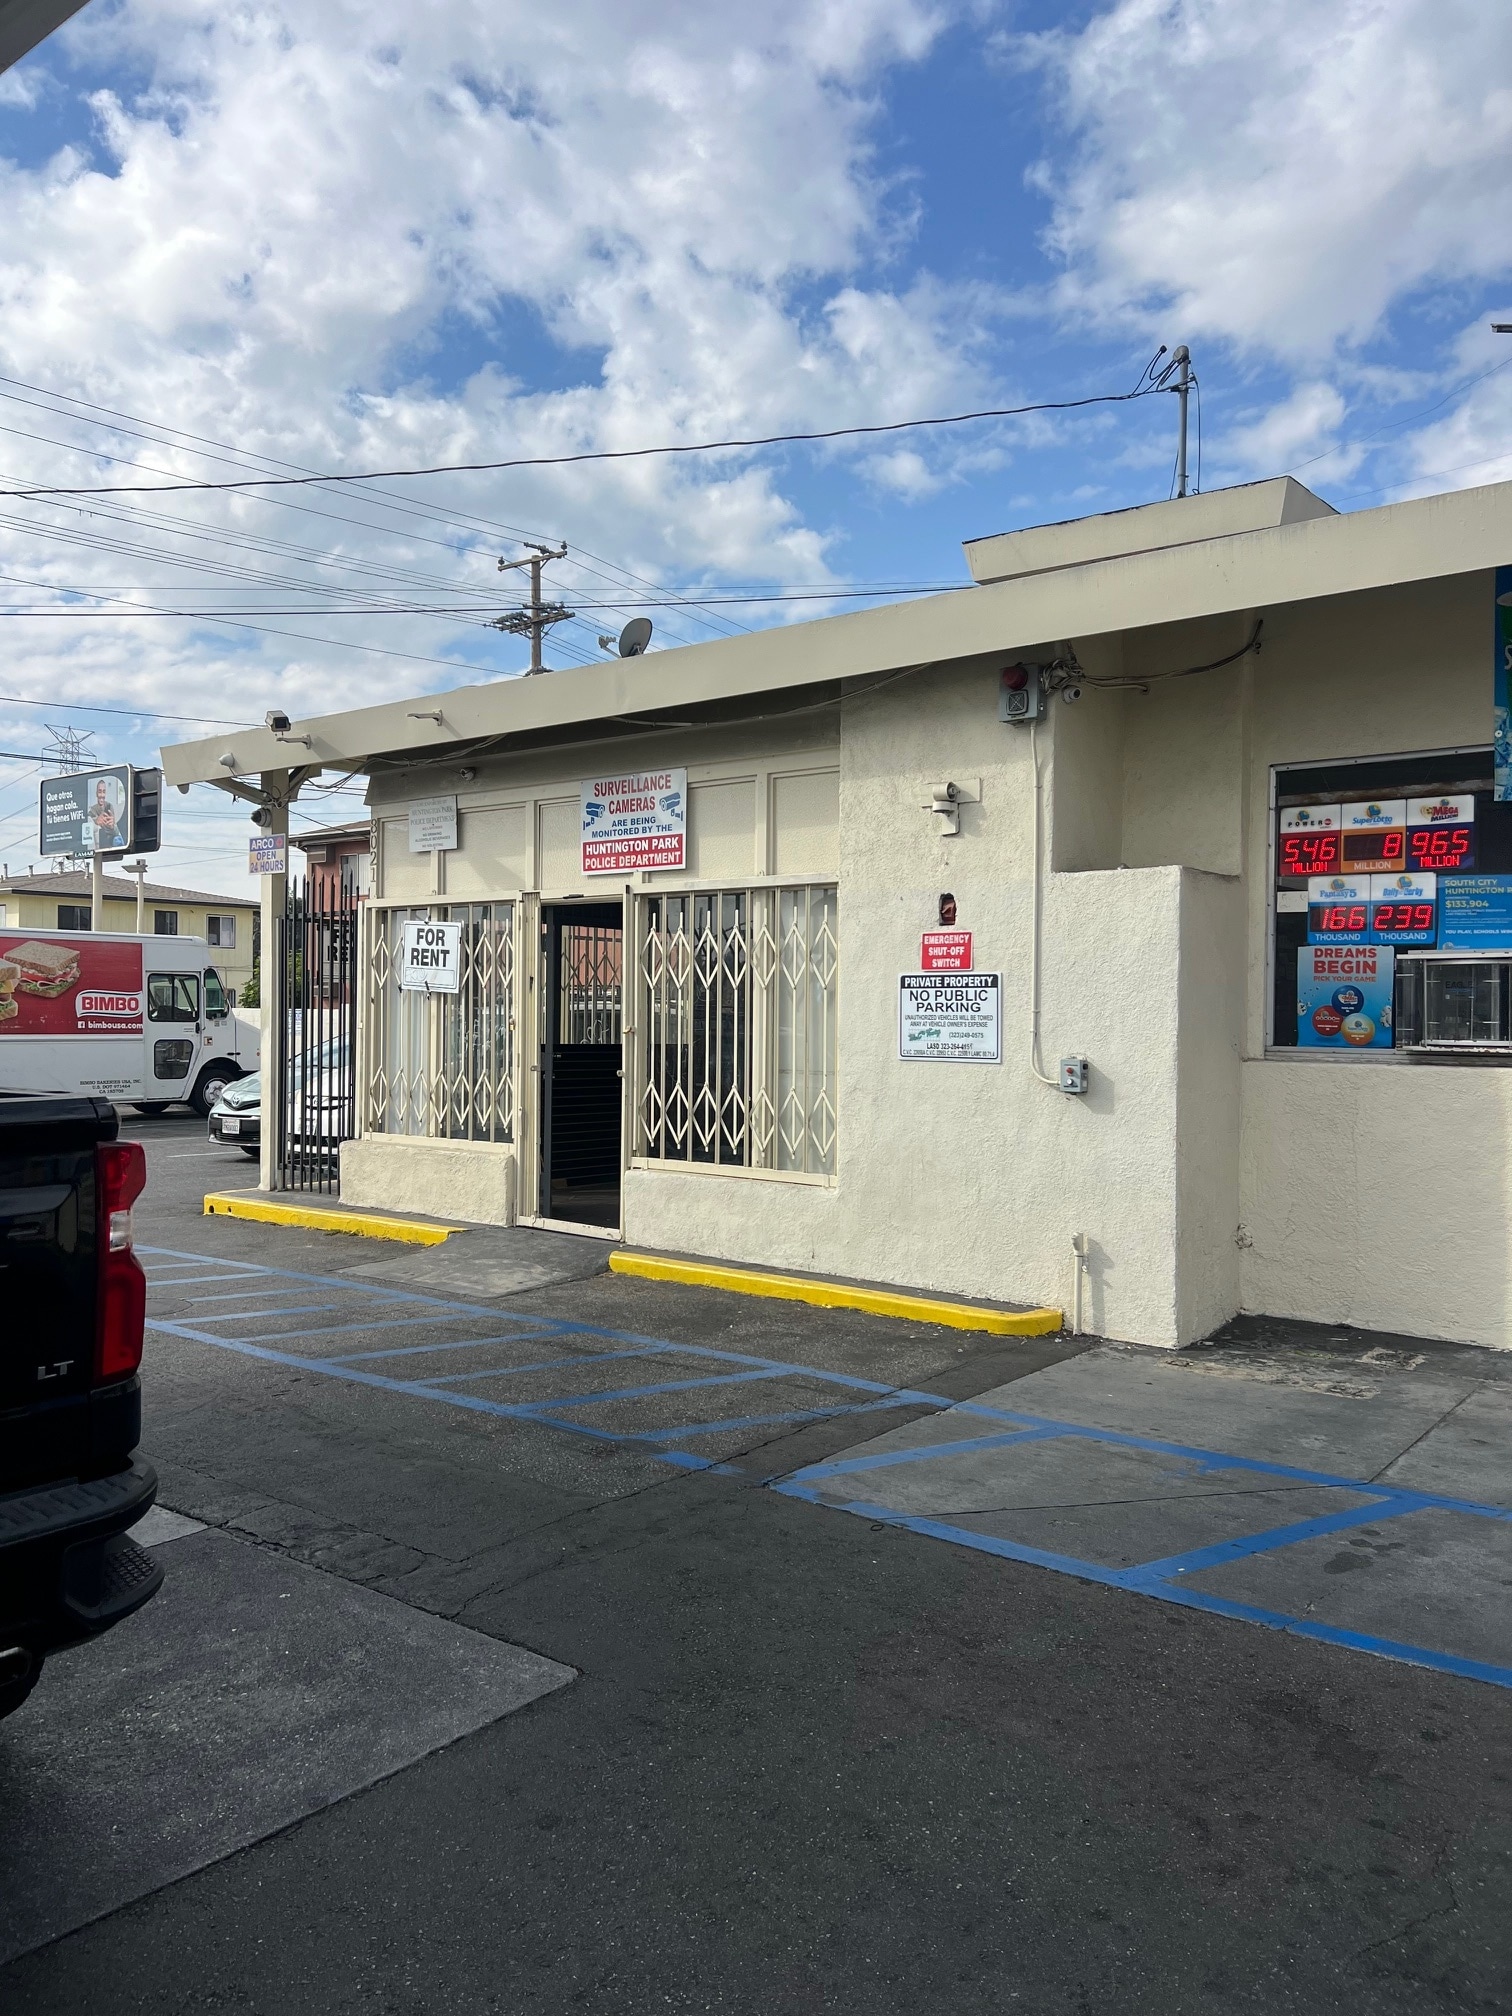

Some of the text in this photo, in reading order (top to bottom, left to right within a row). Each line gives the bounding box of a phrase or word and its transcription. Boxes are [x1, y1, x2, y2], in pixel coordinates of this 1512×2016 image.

[594, 774, 671, 797] SURVEILLANCE
[46, 791, 73, 801] Que otros
[441, 805, 453, 813] PARK
[608, 796, 656, 814] CAMERAS
[1432, 806, 1459, 815] MEGA
[53, 814, 70, 823] tienes
[611, 816, 656, 828] ARE BEING
[592, 824, 673, 838] MONITORED BY THE
[251, 838, 274, 850] ARCO
[585, 837, 679, 856] HUNTINGTON PARK
[1382, 832, 1402, 858] 8
[1411, 829, 1470, 856] 965
[256, 850, 276, 861] OPEN
[1284, 837, 1336, 862] 546
[250, 859, 284, 872] 24 HOURS
[585, 851, 681, 869] POLICE DEPARTMENT
[1353, 861, 1392, 871] MILLION
[1420, 855, 1460, 868] MILLION
[1292, 861, 1328, 873] MILLION
[1444, 878, 1498, 887] SOUTH CITY
[1349, 888, 1357, 898] 5
[1445, 887, 1505, 895] HUNTINGTON
[1445, 900, 1489, 909] $133,904
[1322, 907, 1366, 930] 166
[1373, 905, 1433, 929] 239
[416, 928, 446, 947] FOR
[924, 934, 970, 945] EMERGENCY
[1315, 933, 1361, 941] THOUSAND
[1379, 932, 1428, 940] THOUSAND
[928, 946, 965, 956] SHUT-OFF
[1314, 947, 1377, 959] DREAMS
[410, 947, 450, 968] RENT
[931, 958, 960, 968] SWITCH
[1313, 960, 1377, 974] BEGIN
[904, 976, 993, 988] PRIVATE PROPERTY
[909, 989, 988, 1001] NO PUBLIC
[81, 996, 139, 1012] BIMBO
[916, 1002, 981, 1012] PARKING
[88, 1020, 143, 1029] bimbousa.com
[38, 1360, 75, 1380] LT
